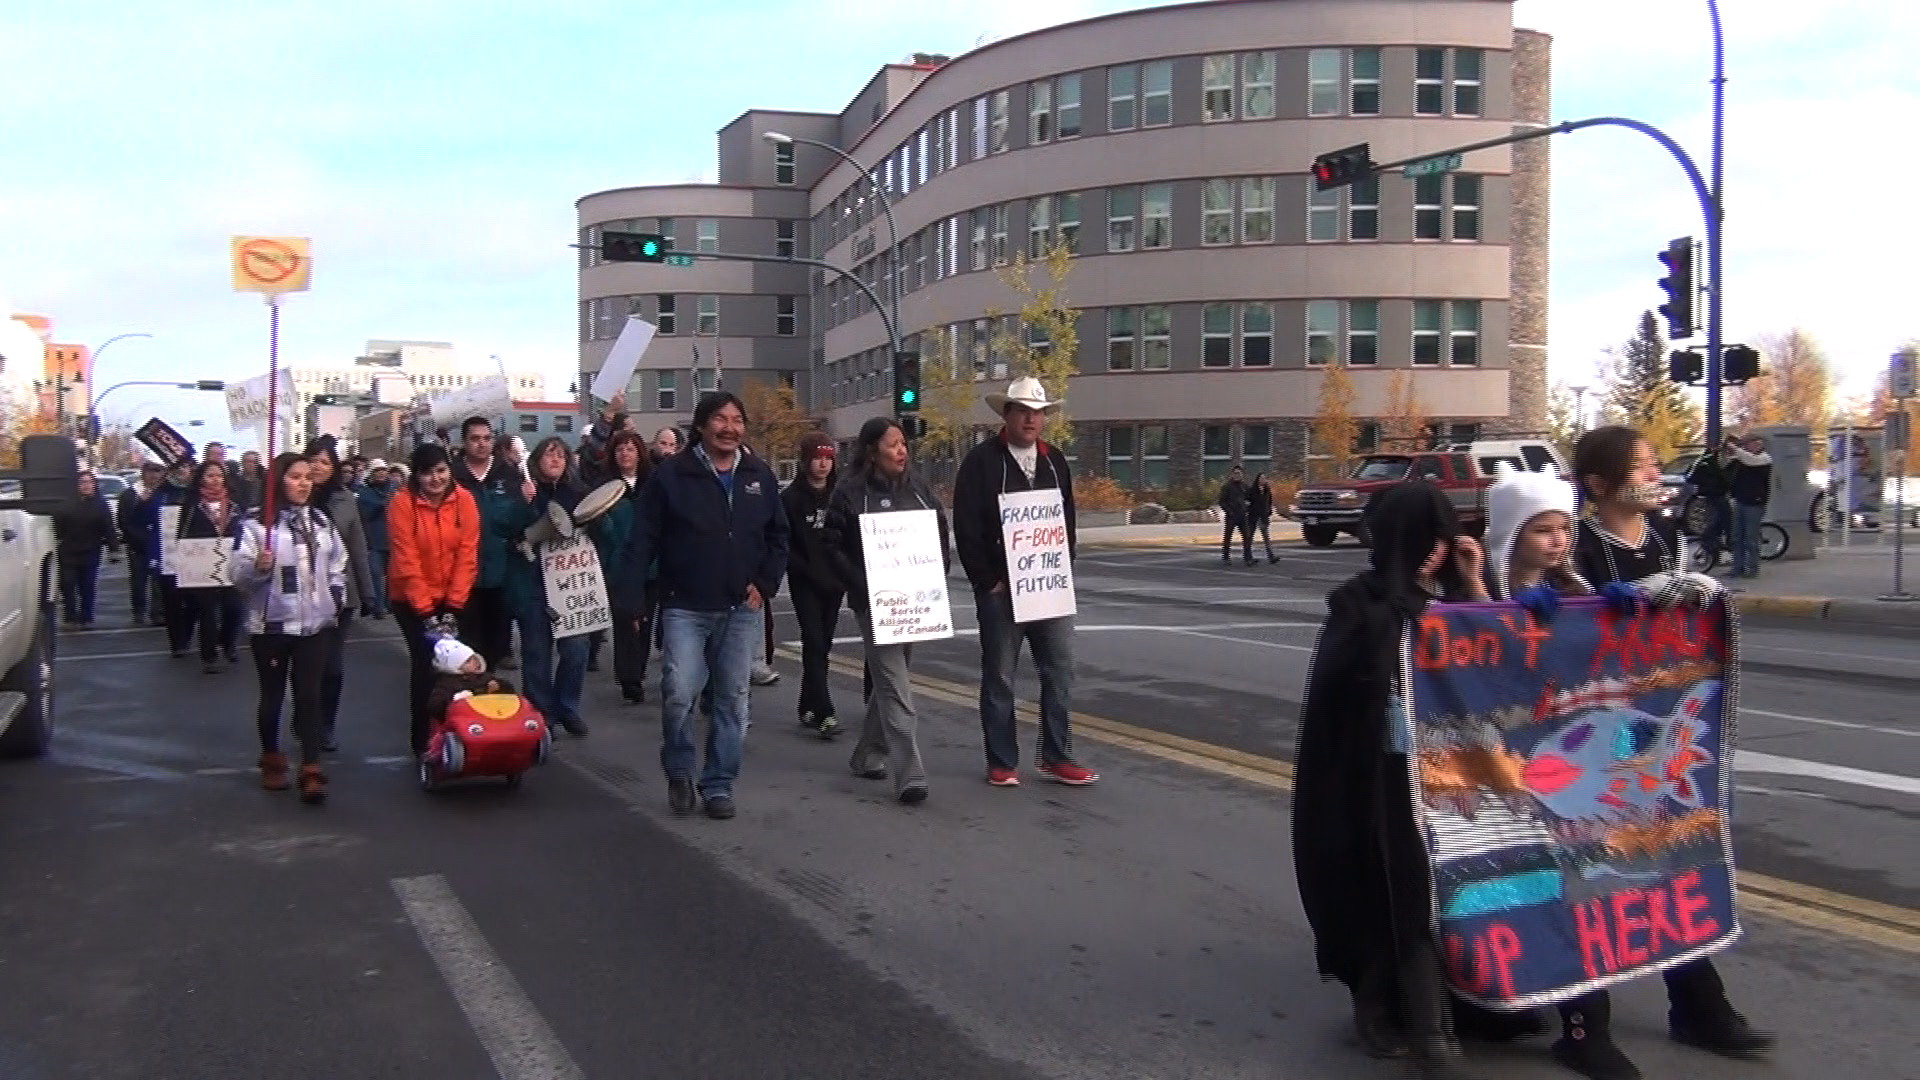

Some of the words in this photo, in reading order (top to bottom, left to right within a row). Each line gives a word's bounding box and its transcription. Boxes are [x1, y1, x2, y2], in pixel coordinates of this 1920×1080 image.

[1001, 504, 1063, 525] FRACKING
[1012, 525, 1066, 550] F-BOMB
[543, 549, 598, 573] FRACK
[1017, 554, 1037, 571] OF
[1041, 551, 1062, 568] THE
[555, 571, 598, 591] WITH
[1016, 573, 1068, 595] FUTURE
[565, 591, 600, 610] OUR
[875, 596, 909, 607] Public
[889, 606, 931, 616] Service
[552, 606, 609, 633] FUTURE
[877, 617, 921, 627] Alliance
[892, 626, 905, 636] of
[907, 623, 949, 635] Canada
[1412, 610, 1552, 671] Don't
[1571, 868, 1720, 978] HERE
[1442, 922, 1522, 1001] UP
